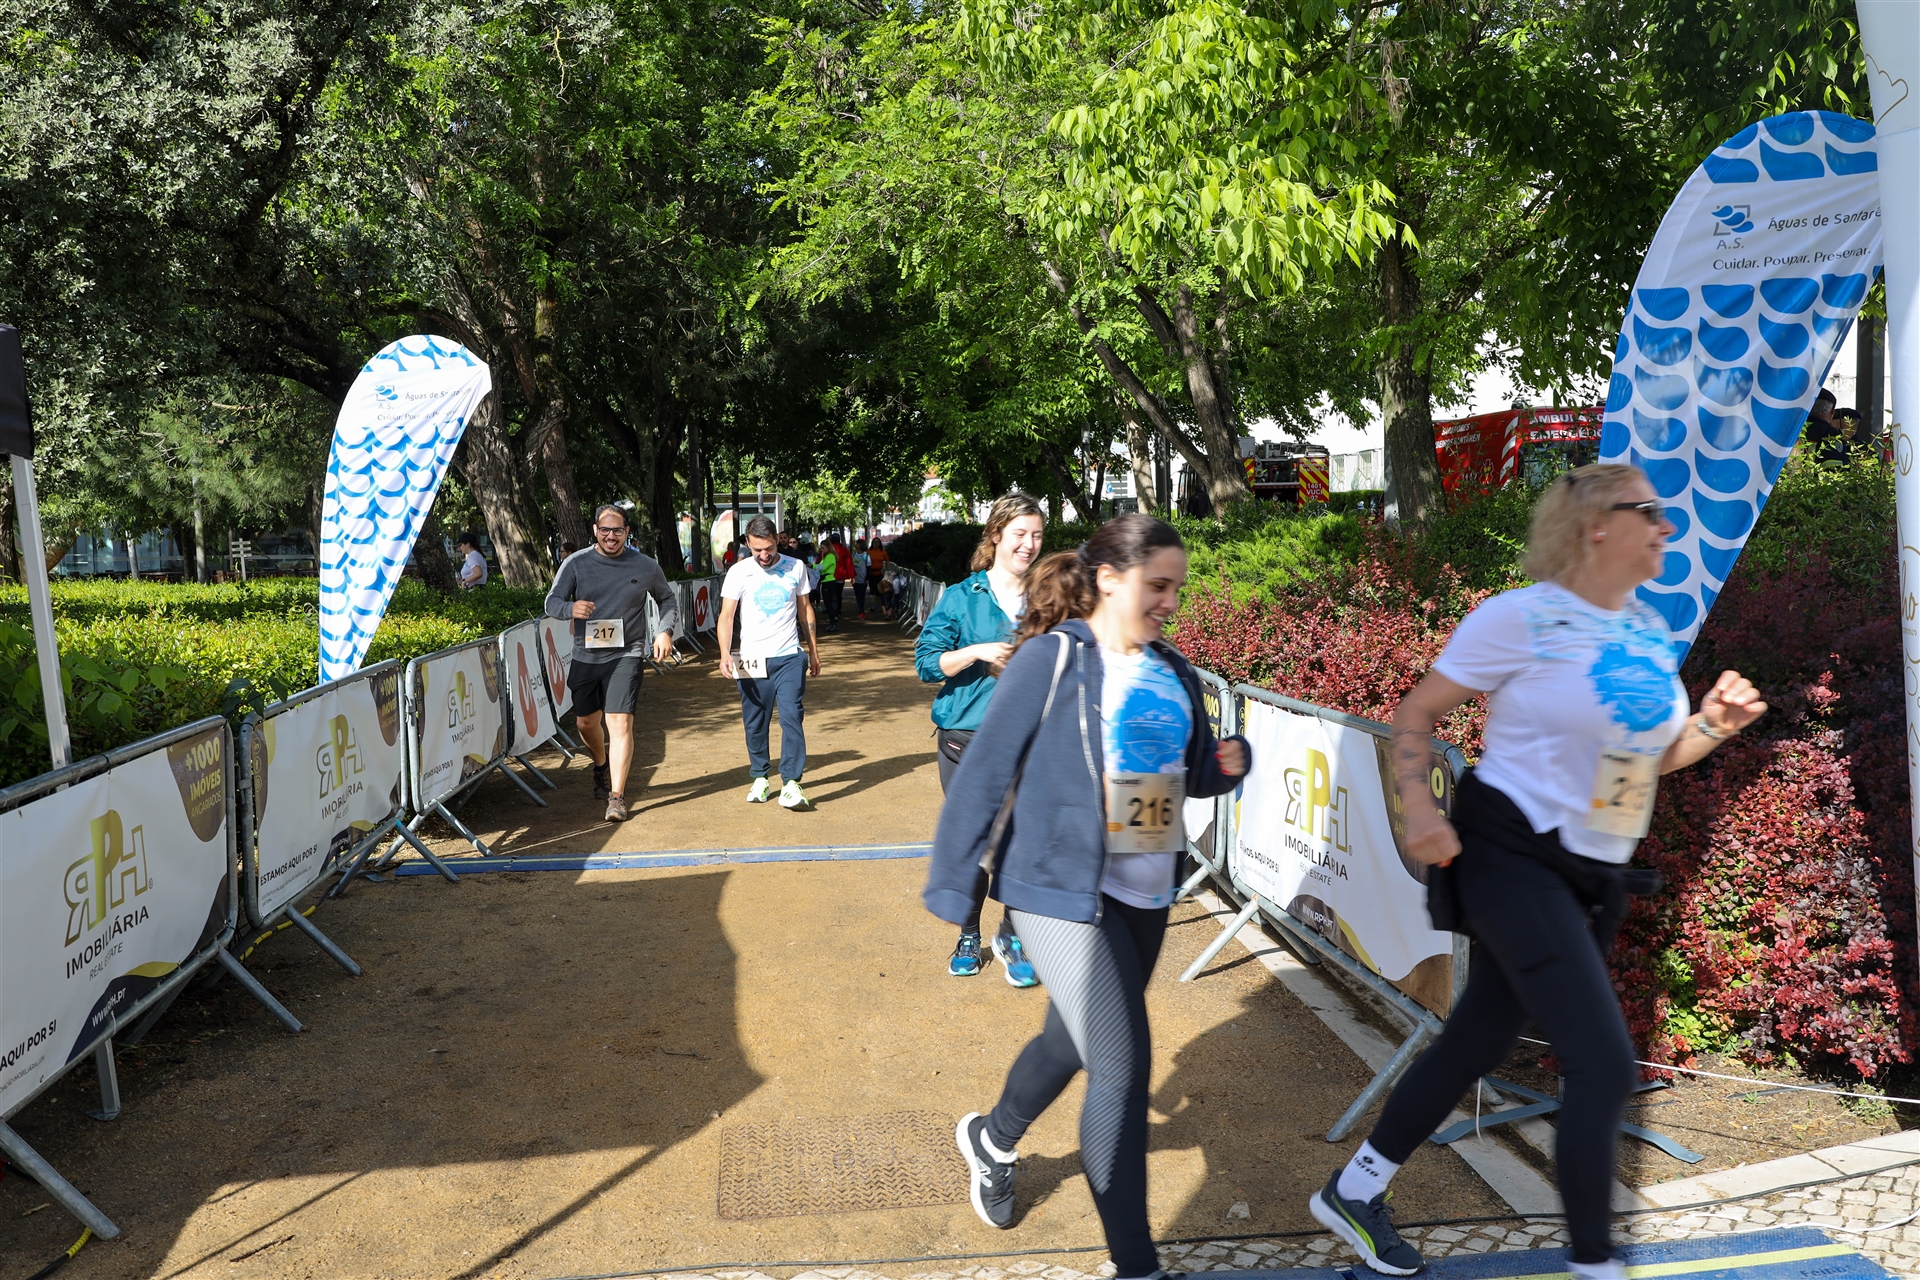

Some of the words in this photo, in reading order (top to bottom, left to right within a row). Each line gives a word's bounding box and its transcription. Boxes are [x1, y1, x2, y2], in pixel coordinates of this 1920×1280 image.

[1768, 216, 1808, 231] Águas
[1812, 214, 1829, 227] de
[1834, 206, 1882, 224] Santaré
[1716, 237, 1745, 250] A.S.
[1713, 257, 1760, 271] Cuidar.
[1764, 253, 1811, 267] Poupar.
[593, 627, 615, 640] 217
[738, 659, 758, 670] 214
[184, 736, 221, 772] +1000
[189, 768, 222, 802] IMÓVEIS
[1127, 797, 1174, 827] 216
[260, 862, 288, 886] ESTAMOS
[288, 854, 302, 870] AQUI
[302, 847, 313, 861] POR
[1284, 834, 1349, 881] IMOBILIÁRIA
[1309, 867, 1332, 886] ESTATE
[66, 905, 150, 979] IMOBILIÁRIA
[89, 964, 105, 981] REAL
[0, 1042, 26, 1072] AQUI
[27, 1027, 47, 1052] POR
[48, 1019, 57, 1037] SI
